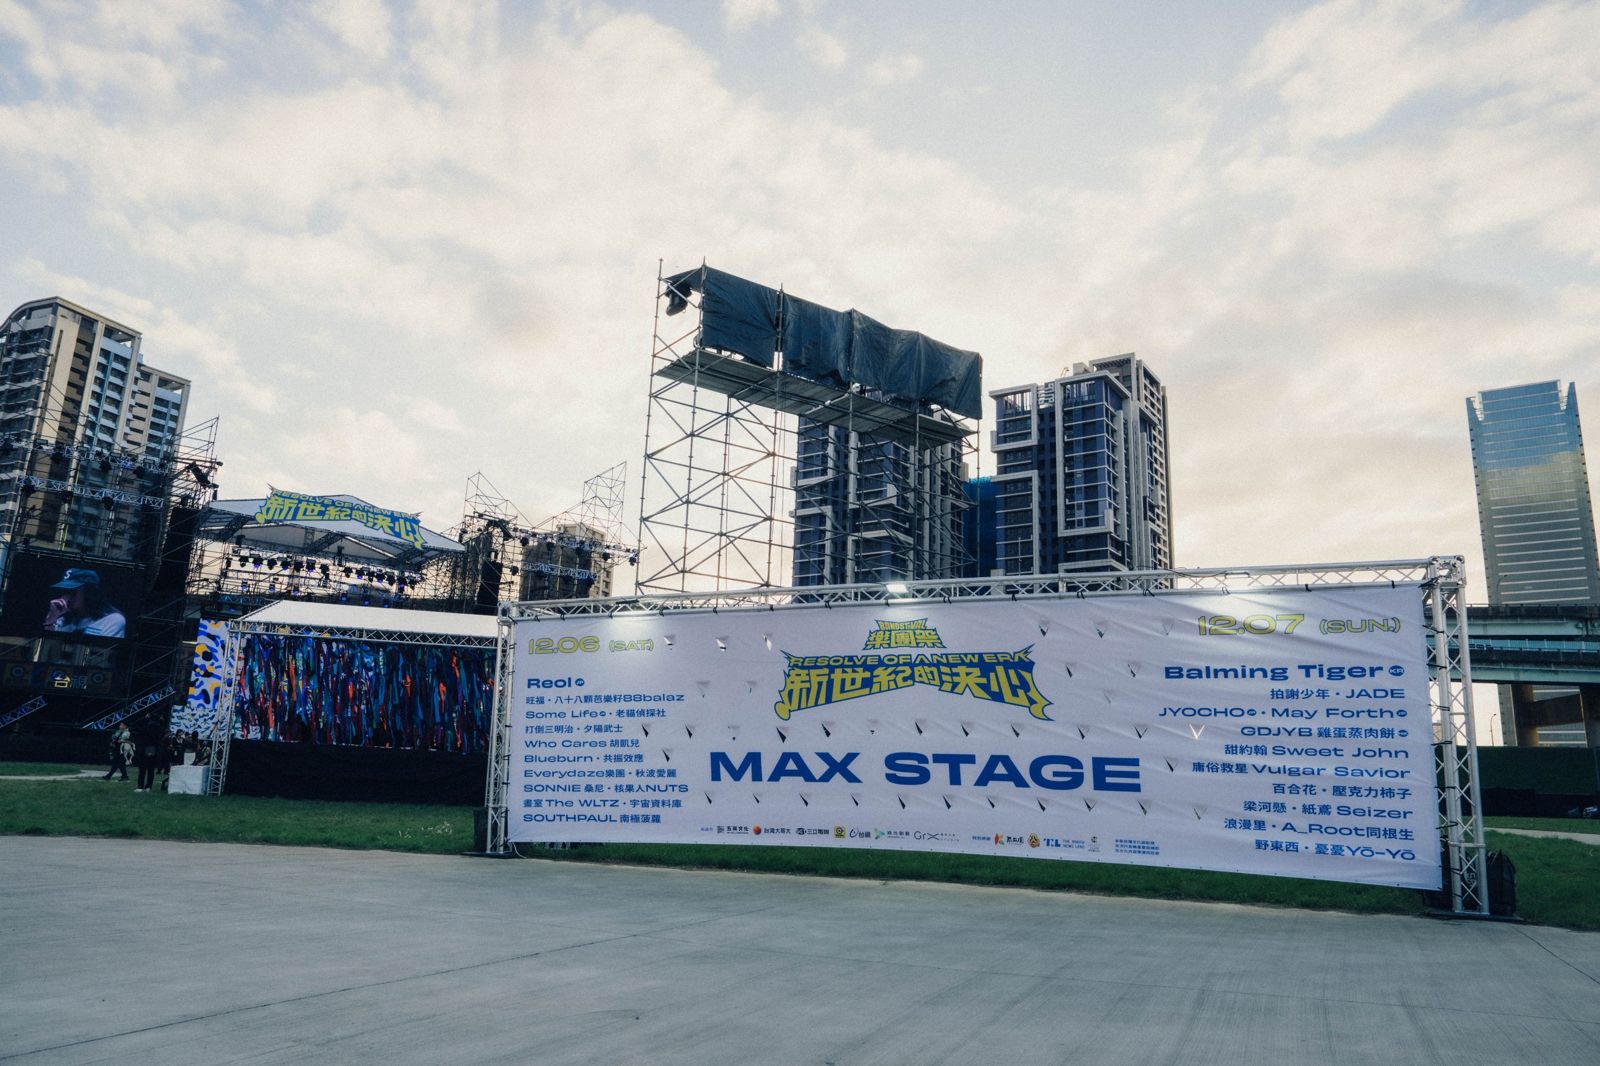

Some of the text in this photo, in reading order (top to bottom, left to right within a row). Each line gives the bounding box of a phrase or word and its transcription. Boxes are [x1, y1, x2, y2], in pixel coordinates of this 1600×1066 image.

[255, 496, 428, 550] 新世紀的決心
[1198, 613, 1402, 636] 12.07 (SUN.)
[528, 635, 600, 655] 12.06
[790, 651, 1030, 667] RESOLVE OF A NEW ERA
[1164, 665, 1289, 681] Balming
[1298, 664, 1384, 681] Tiger
[527, 677, 572, 689] Reol
[774, 664, 1054, 721] 新世紀的決心
[1270, 688, 1406, 700] 拍謝少年 JADE
[525, 710, 567, 719] Some
[571, 710, 598, 718] Life
[1158, 707, 1247, 718] JYOCHO
[1271, 708, 1318, 720] May
[1326, 708, 1394, 718] Forth
[525, 724, 623, 734] 打倒三明治 夕陽武士
[1240, 726, 1313, 738] GDJYB
[524, 739, 557, 748] Who
[561, 739, 607, 748] Cares
[524, 754, 593, 763] Blueburn
[1224, 744, 1409, 759] 甜約翰 Sweet John
[709, 751, 1142, 792] MAX STAGE
[1192, 761, 1411, 779] 庸俗救星 Vulgar Savior
[523, 784, 581, 793] SONNIE
[1272, 783, 1412, 800] 百合花 壓克力柿子
[545, 799, 574, 808] The
[578, 799, 619, 808] WLTZ
[523, 814, 617, 823] SOUTHPAUL
[1336, 805, 1414, 819] Seizer
[1255, 839, 1299, 853] 野東西
